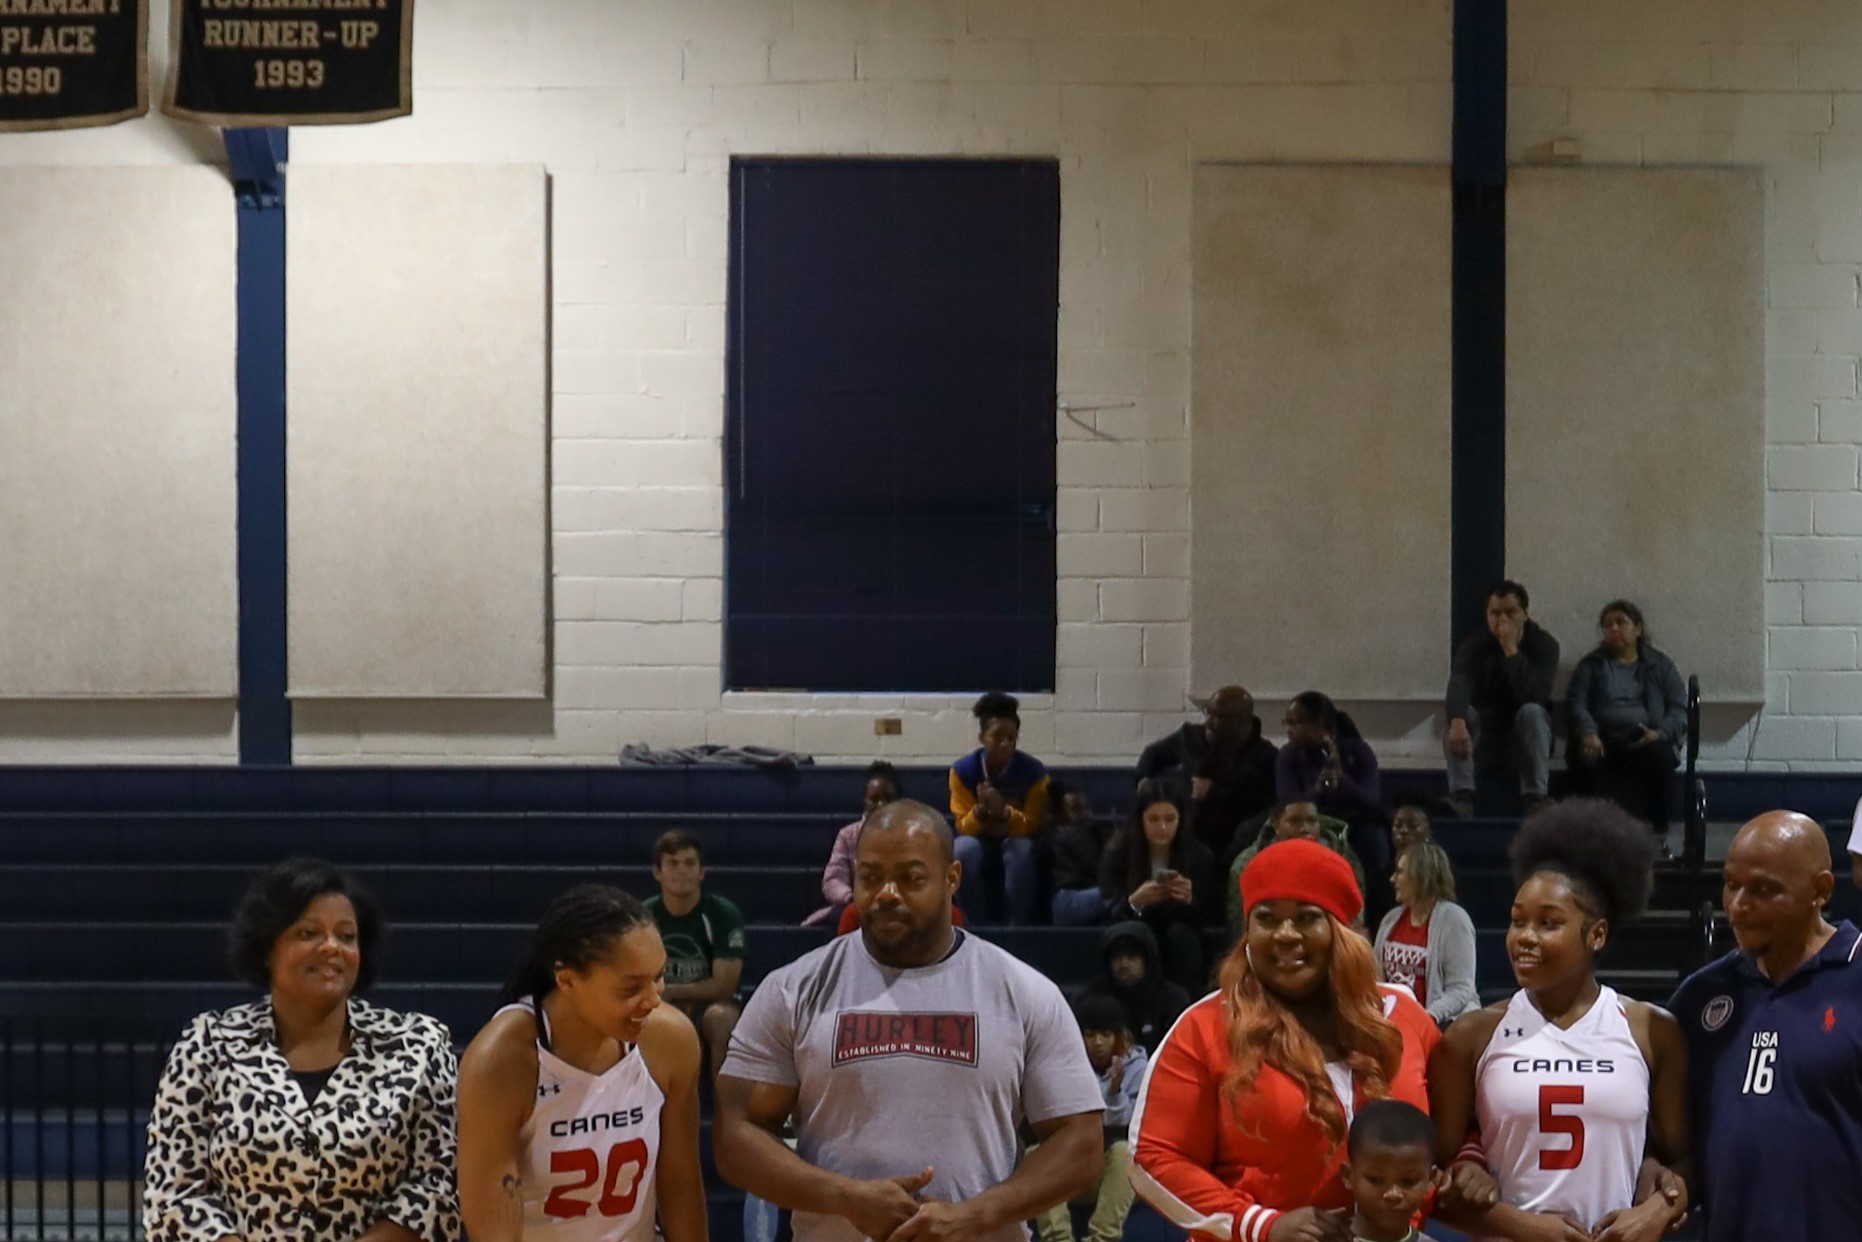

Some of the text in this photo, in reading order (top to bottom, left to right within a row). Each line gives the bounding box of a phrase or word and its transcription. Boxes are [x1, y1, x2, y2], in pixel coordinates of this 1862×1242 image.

[1, 26, 96, 54] PLACE
[203, 19, 379, 48] RUNNER-UP
[254, 59, 325, 89] 1993
[838, 1014, 971, 1046] HURLEY
[1752, 1031, 1779, 1048] USA
[838, 1043, 971, 1060] ESTABLISHED IN NINETY NINE
[1513, 1059, 1615, 1073] CANES
[1742, 1048, 1777, 1095] 16
[550, 1106, 644, 1137] CANES
[1539, 1085, 1585, 1171] 5
[543, 1137, 649, 1219] 20
